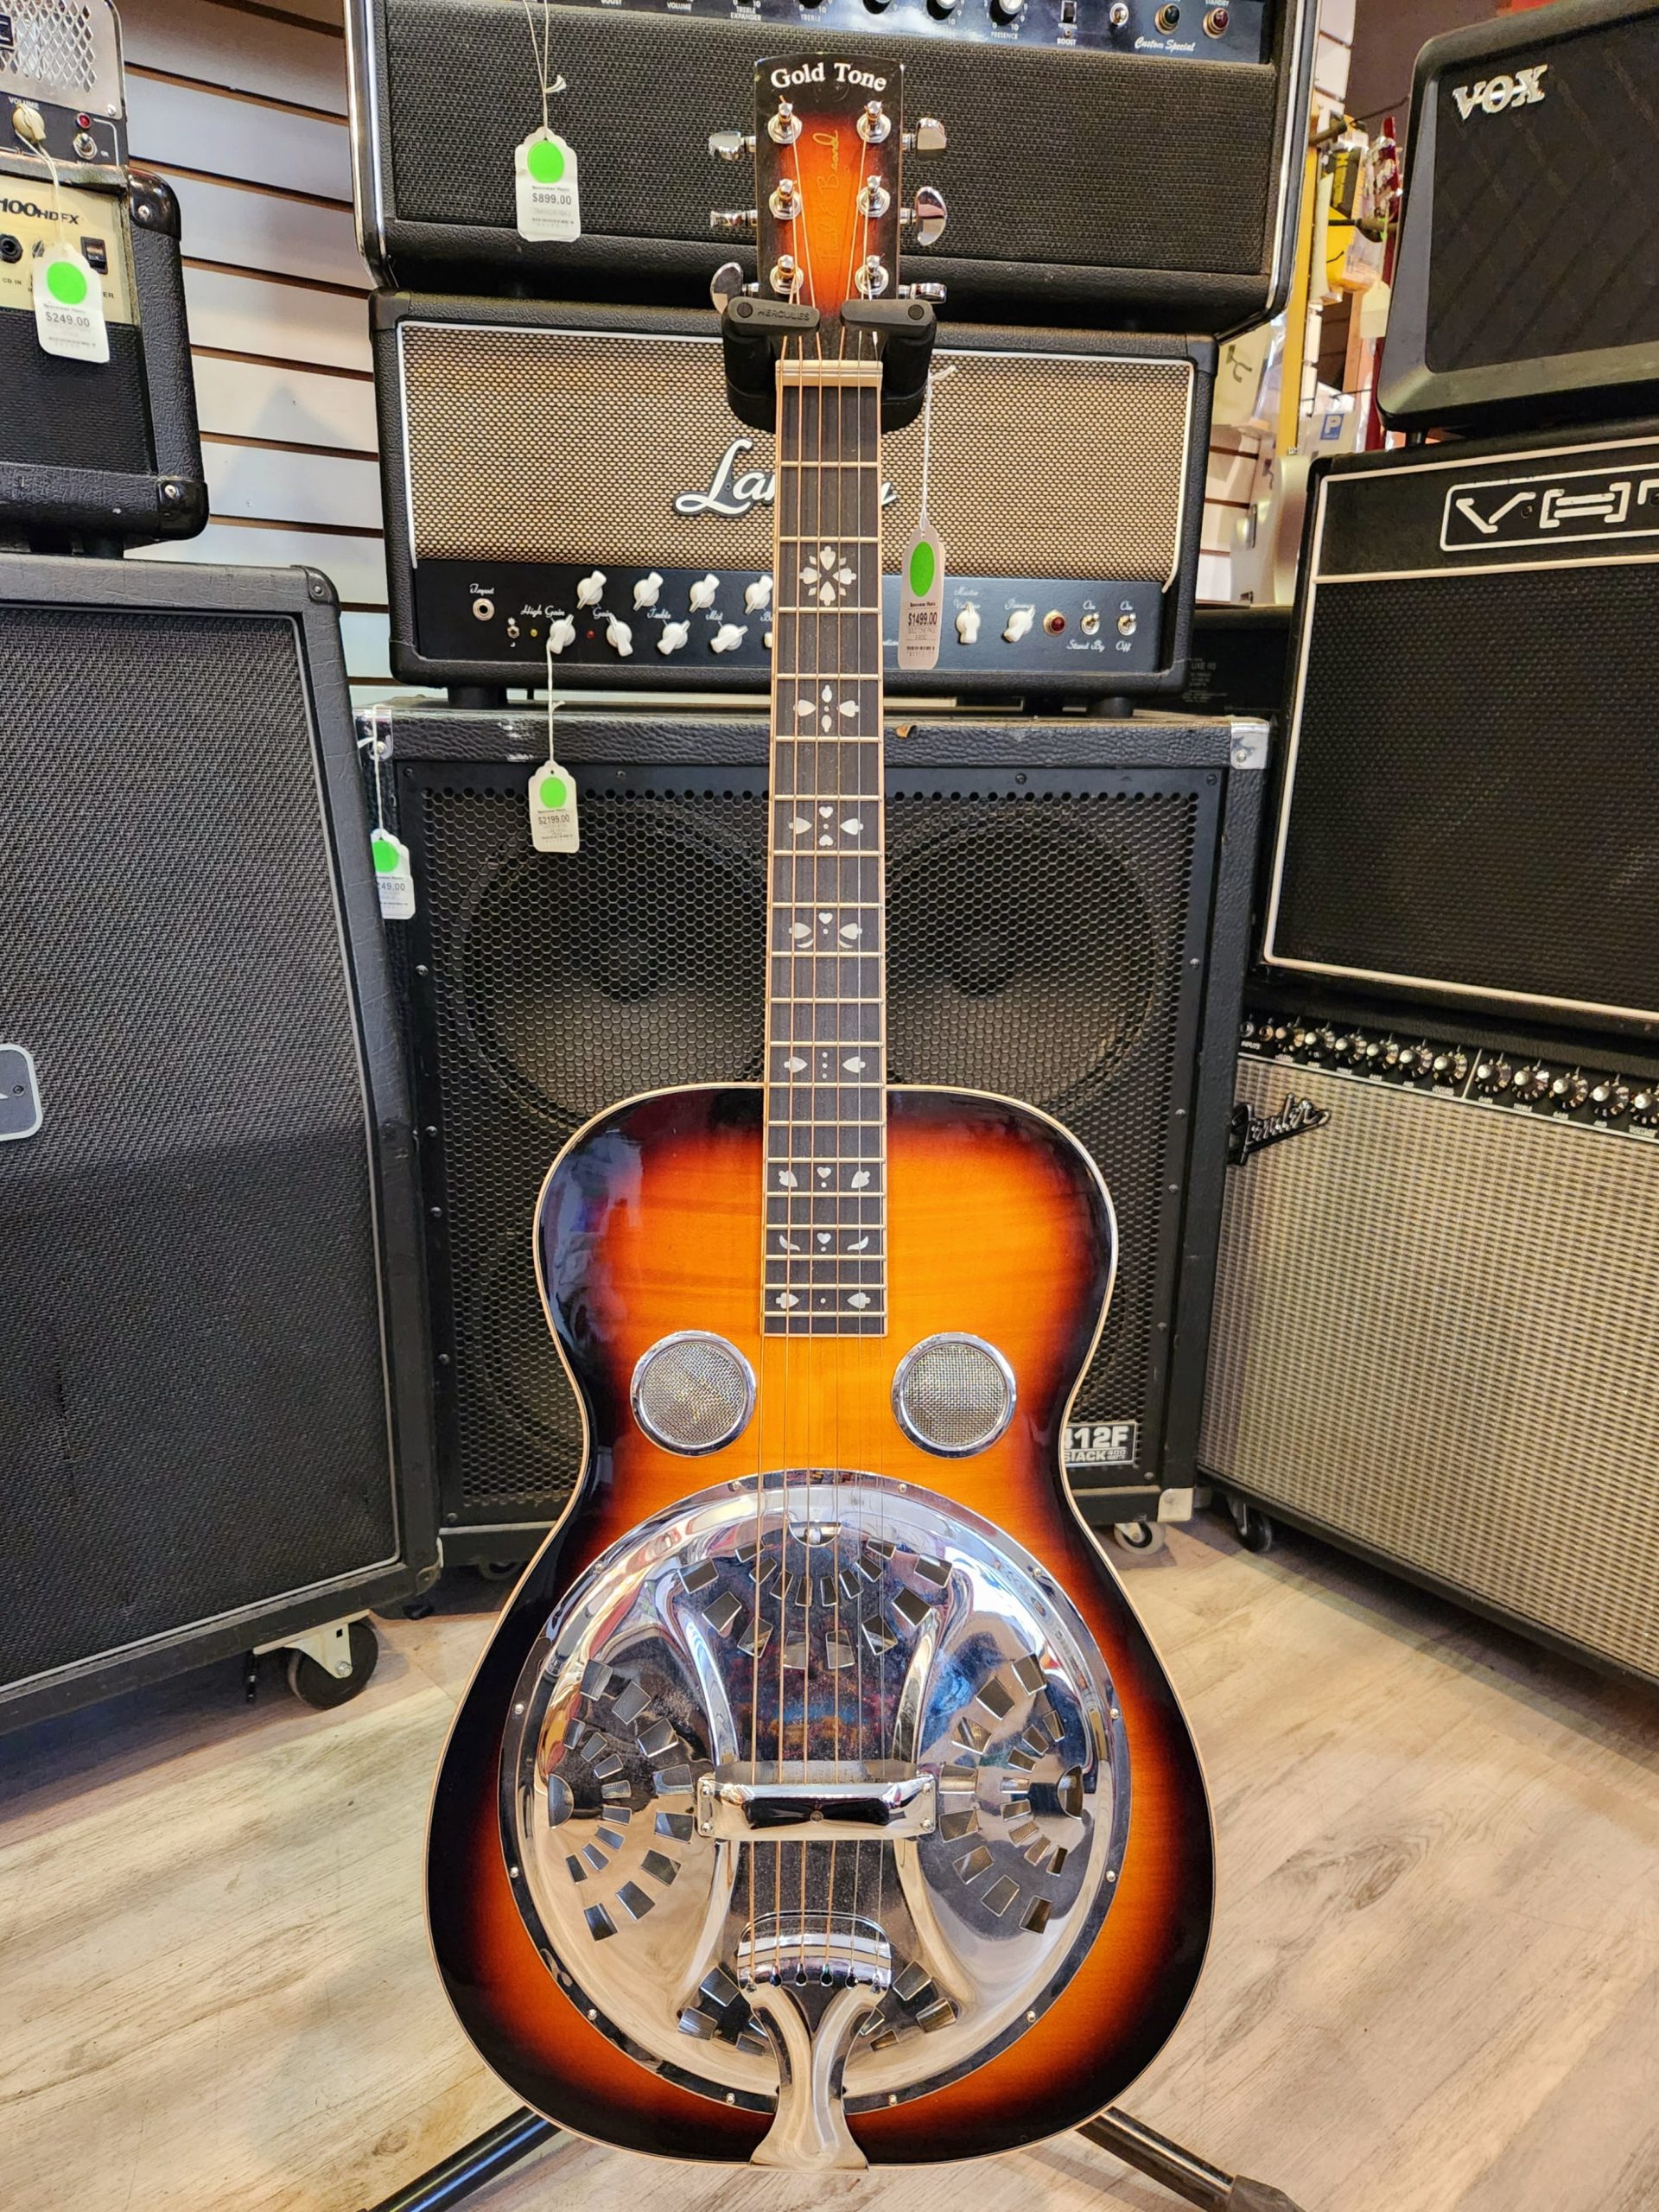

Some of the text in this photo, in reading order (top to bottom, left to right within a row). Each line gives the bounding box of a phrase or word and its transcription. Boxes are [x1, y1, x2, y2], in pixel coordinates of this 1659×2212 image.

[736, 5, 756, 14] TREBLE
[730, 12, 761, 21] EXPANDER
[991, 31, 1018, 40] PRESENCE
[1135, 36, 1196, 53] Custom Special
[771, 62, 887, 91] Gold Tone
[1452, 64, 1548, 120] VOX
[532, 193, 572, 206] $899.00
[46, 311, 90, 327] $249.00
[757, 308, 810, 321] HERCULES
[520, 605, 565, 618] High Gain
[908, 612, 938, 626] $1499.00
[538, 814, 570, 825] $2199.00
[1241, 1040, 1262, 1051] INPUTS
